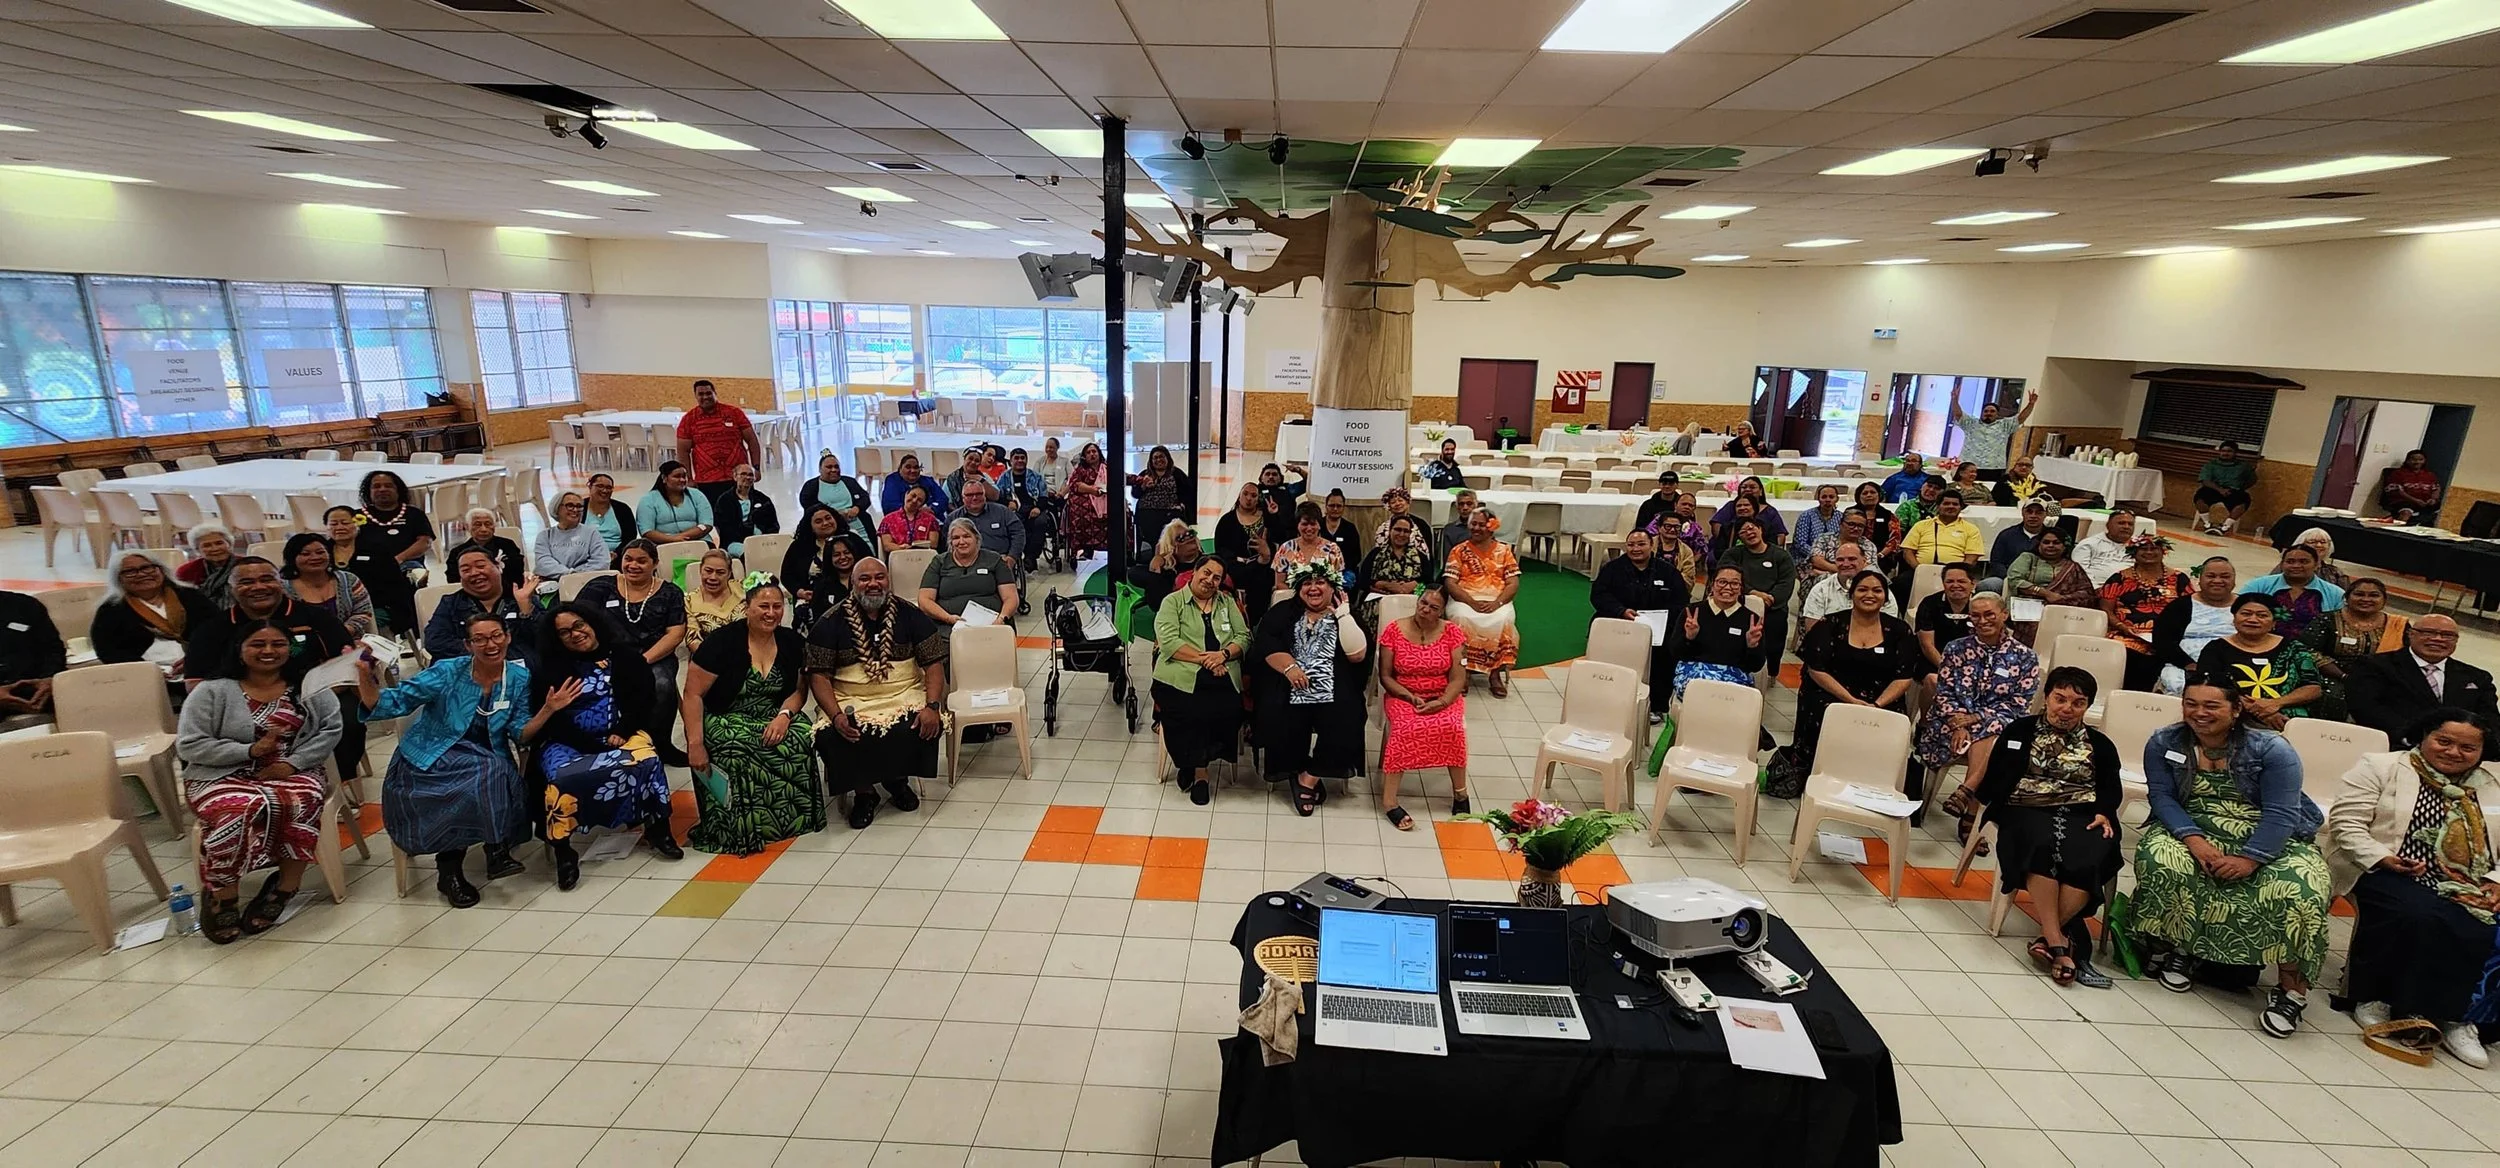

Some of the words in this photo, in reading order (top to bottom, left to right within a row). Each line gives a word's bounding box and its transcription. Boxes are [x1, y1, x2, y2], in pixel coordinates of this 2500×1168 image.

[284, 367, 322, 376] VALUES
[1331, 448, 1382, 456] FACILITATORS
[1321, 462, 1356, 470] BREAKOUT
